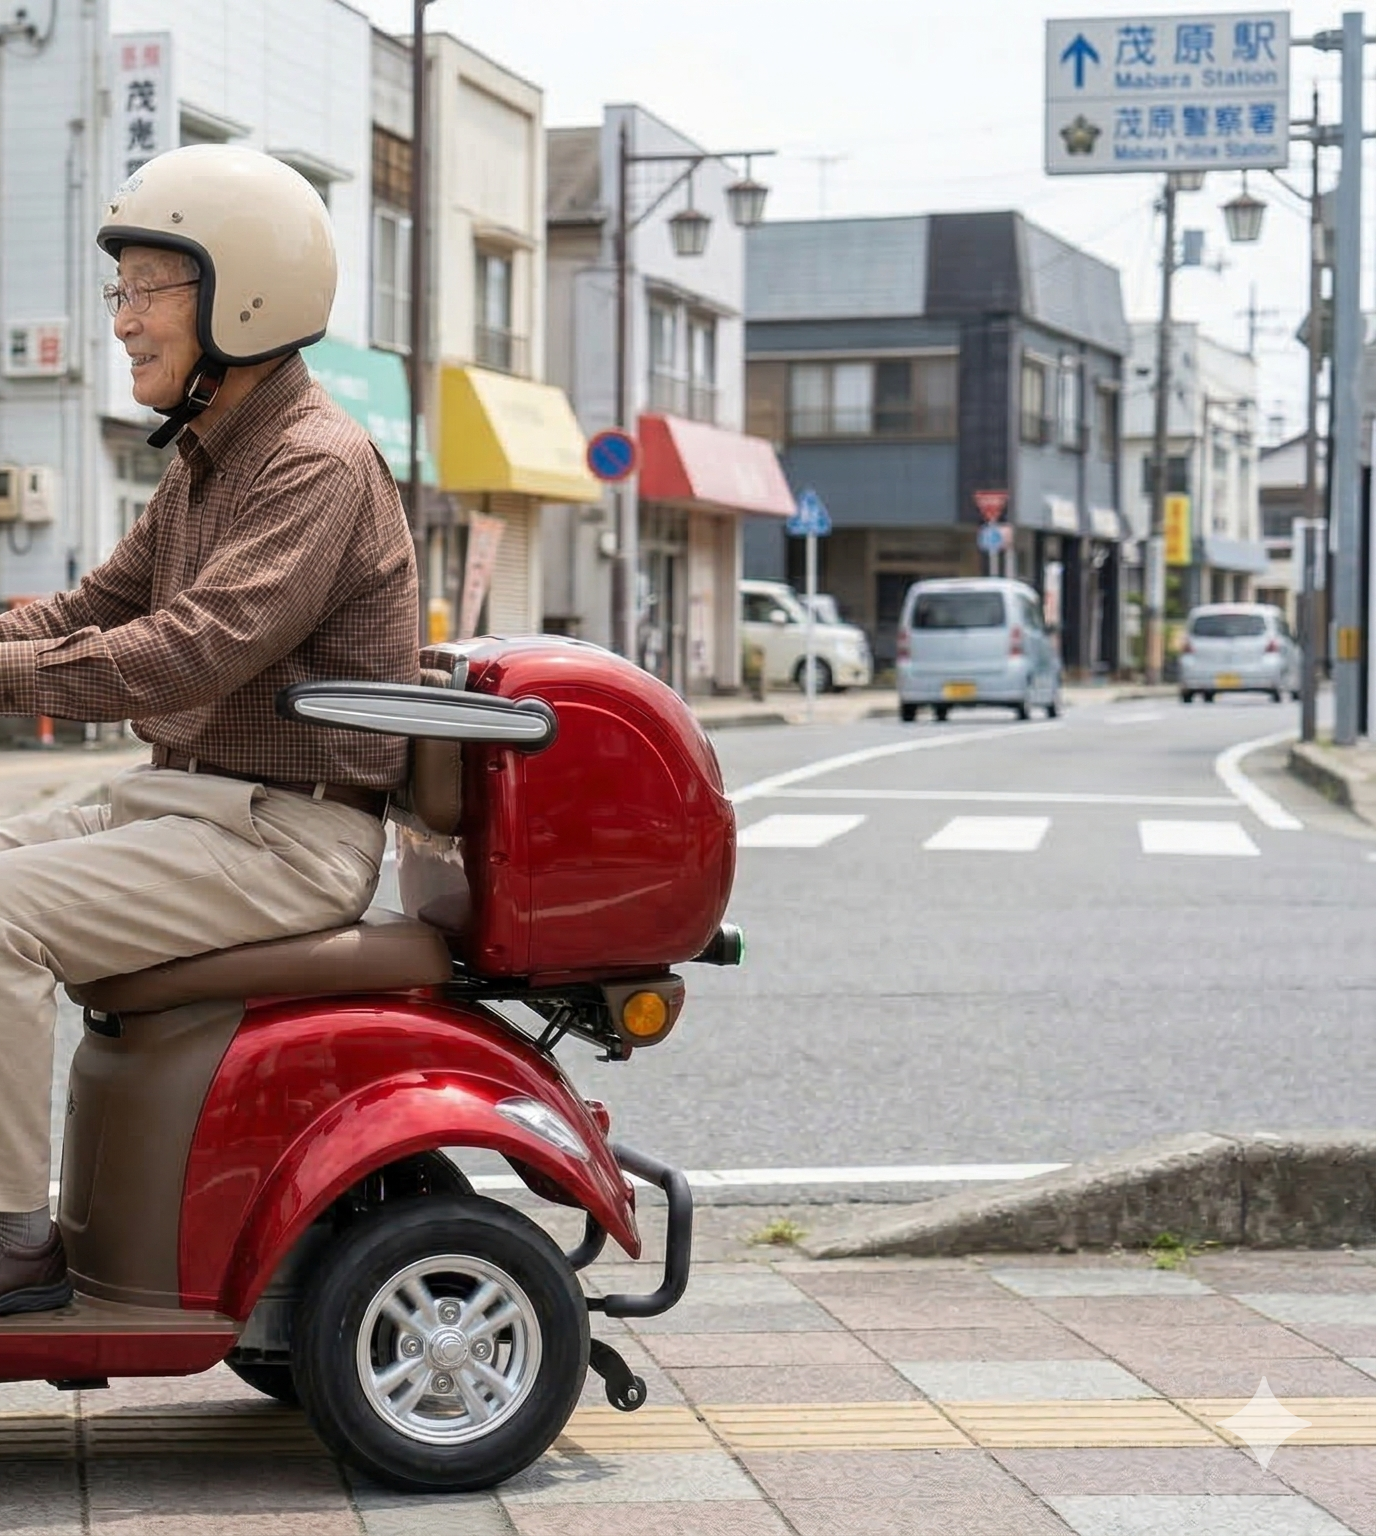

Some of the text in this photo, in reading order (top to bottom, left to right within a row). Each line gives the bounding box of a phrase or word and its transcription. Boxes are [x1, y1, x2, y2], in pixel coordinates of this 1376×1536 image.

[1115, 20, 1276, 65] 茂原駅
[1202, 69, 1279, 87] Station
[1114, 103, 1276, 139] 茂原警察署
